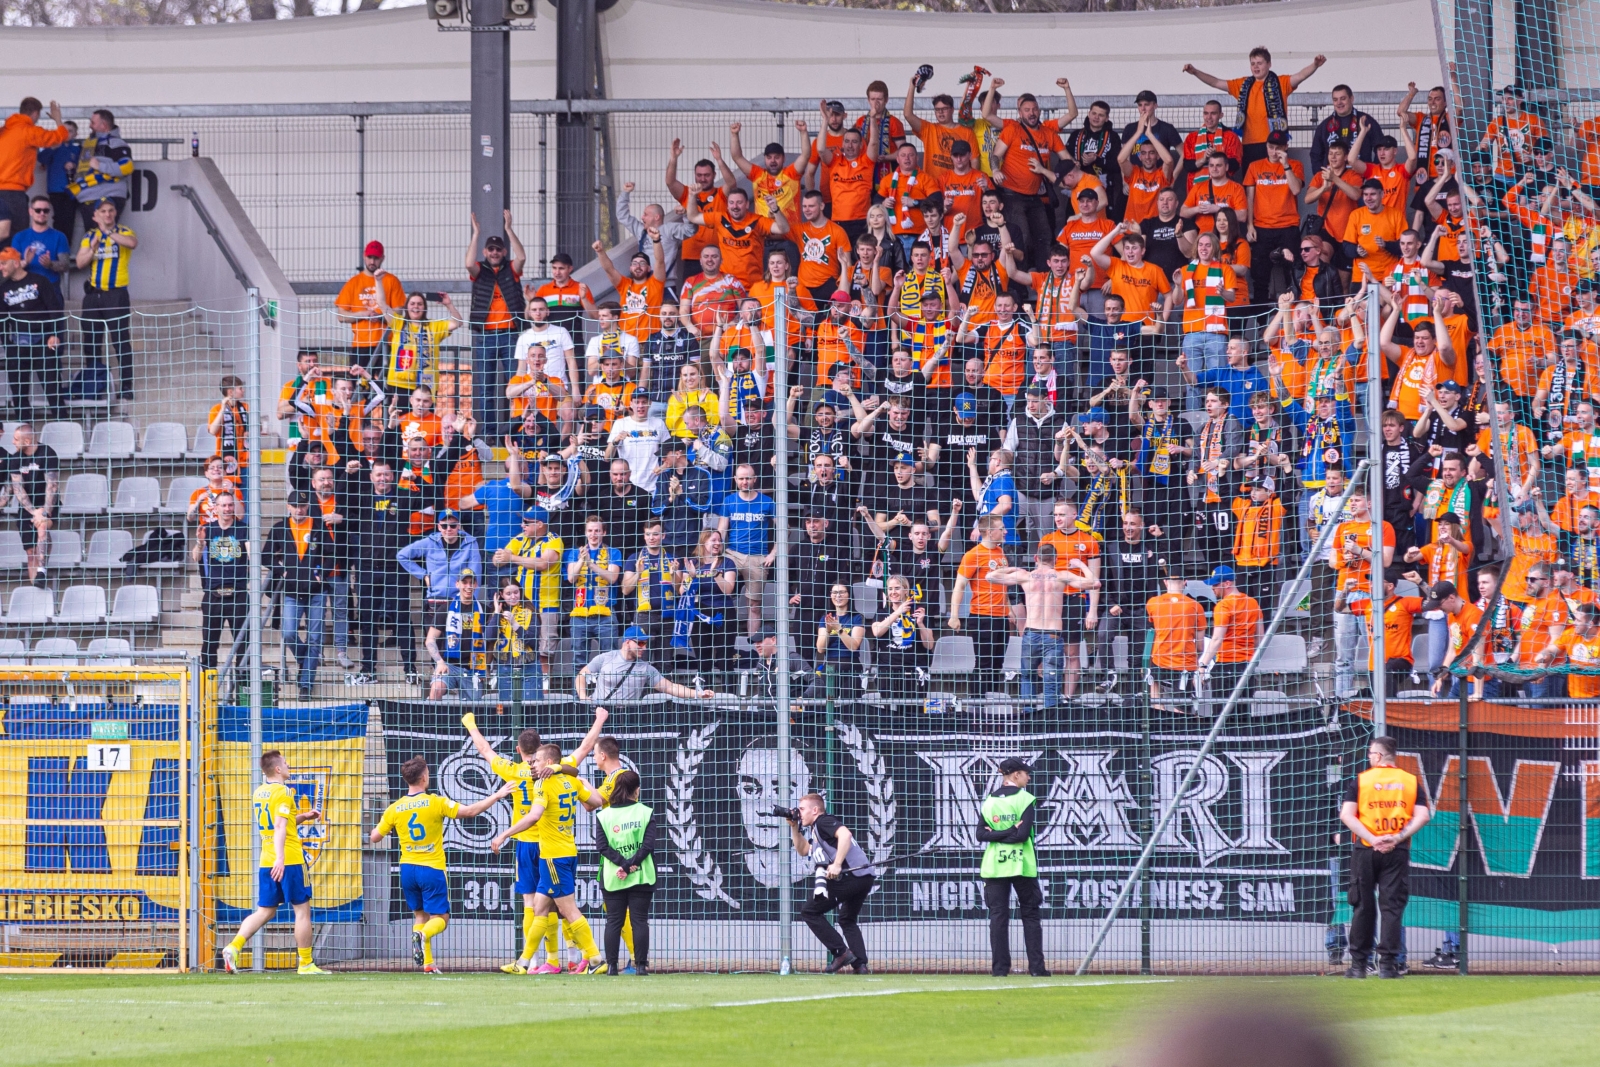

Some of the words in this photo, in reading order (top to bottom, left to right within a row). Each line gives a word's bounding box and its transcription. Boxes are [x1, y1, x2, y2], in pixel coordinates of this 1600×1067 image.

[131, 169, 158, 212] D
[1071, 230, 1103, 238] CHOJNÓW
[723, 236, 752, 247] KGHM
[947, 434, 964, 445] ARKA
[965, 434, 987, 444] GDYNIA
[98, 748, 121, 767] 17
[395, 800, 429, 812] MILEWSKI
[999, 814, 1017, 822] IMPEL
[408, 813, 425, 841] 6
[621, 822, 641, 831] IMPEL
[1238, 881, 1296, 912] SAM
